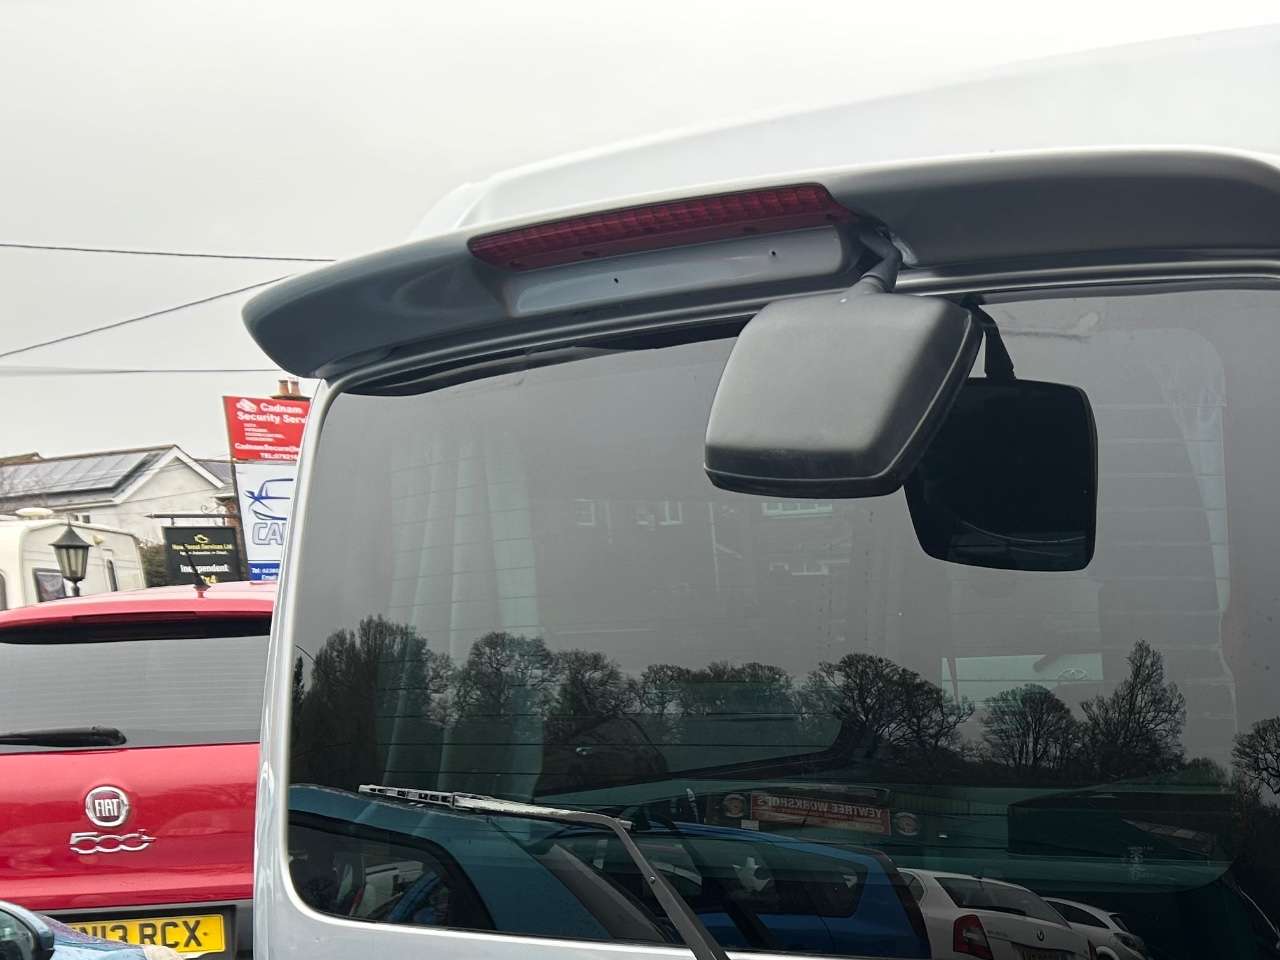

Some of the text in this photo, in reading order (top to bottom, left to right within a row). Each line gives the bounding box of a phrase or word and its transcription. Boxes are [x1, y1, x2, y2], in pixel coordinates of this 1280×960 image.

[236, 410, 280, 424] Security
[260, 402, 304, 414] Cadnam
[251, 522, 284, 545] CA
[94, 799, 120, 817] FIAT
[139, 919, 202, 948] RCX
